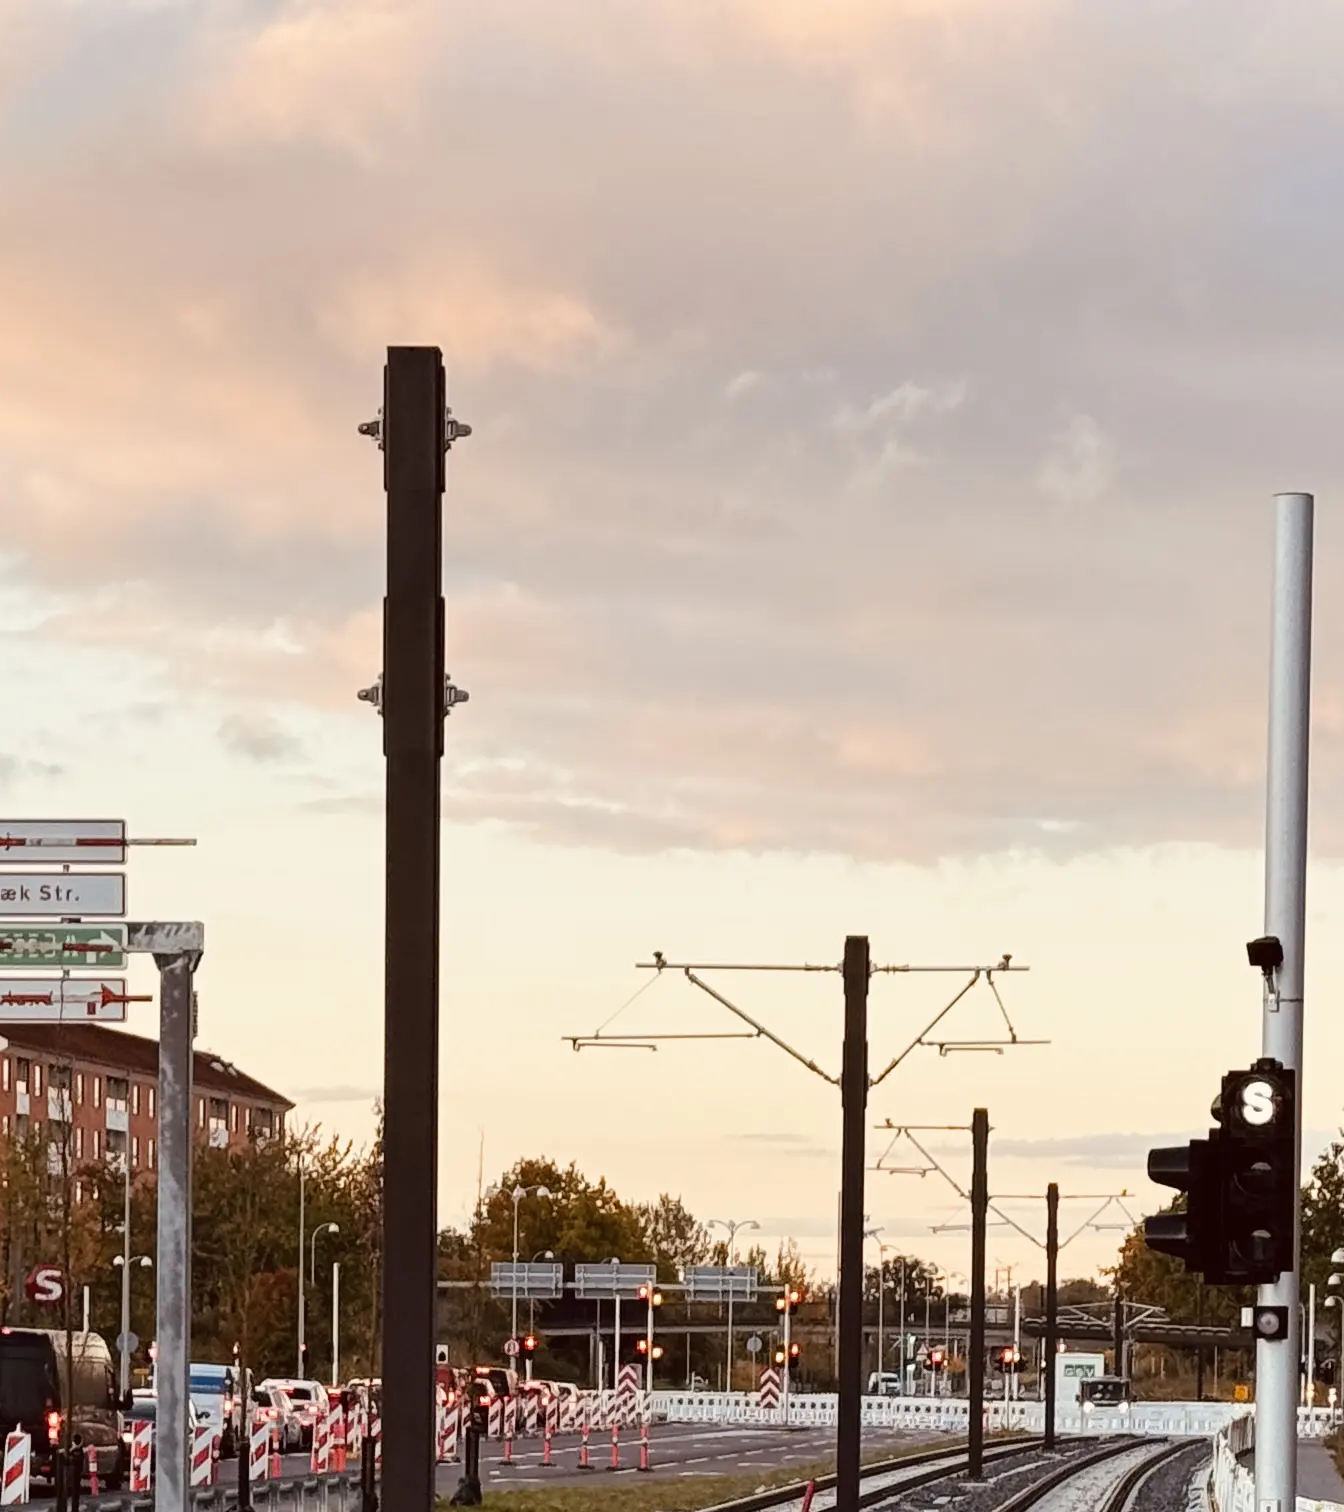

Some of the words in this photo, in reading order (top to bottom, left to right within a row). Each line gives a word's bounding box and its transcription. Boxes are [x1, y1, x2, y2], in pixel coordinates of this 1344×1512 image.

[39, 885, 81, 902] Str.
[1242, 1081, 1274, 1126] S
[35, 1269, 63, 1301] S
